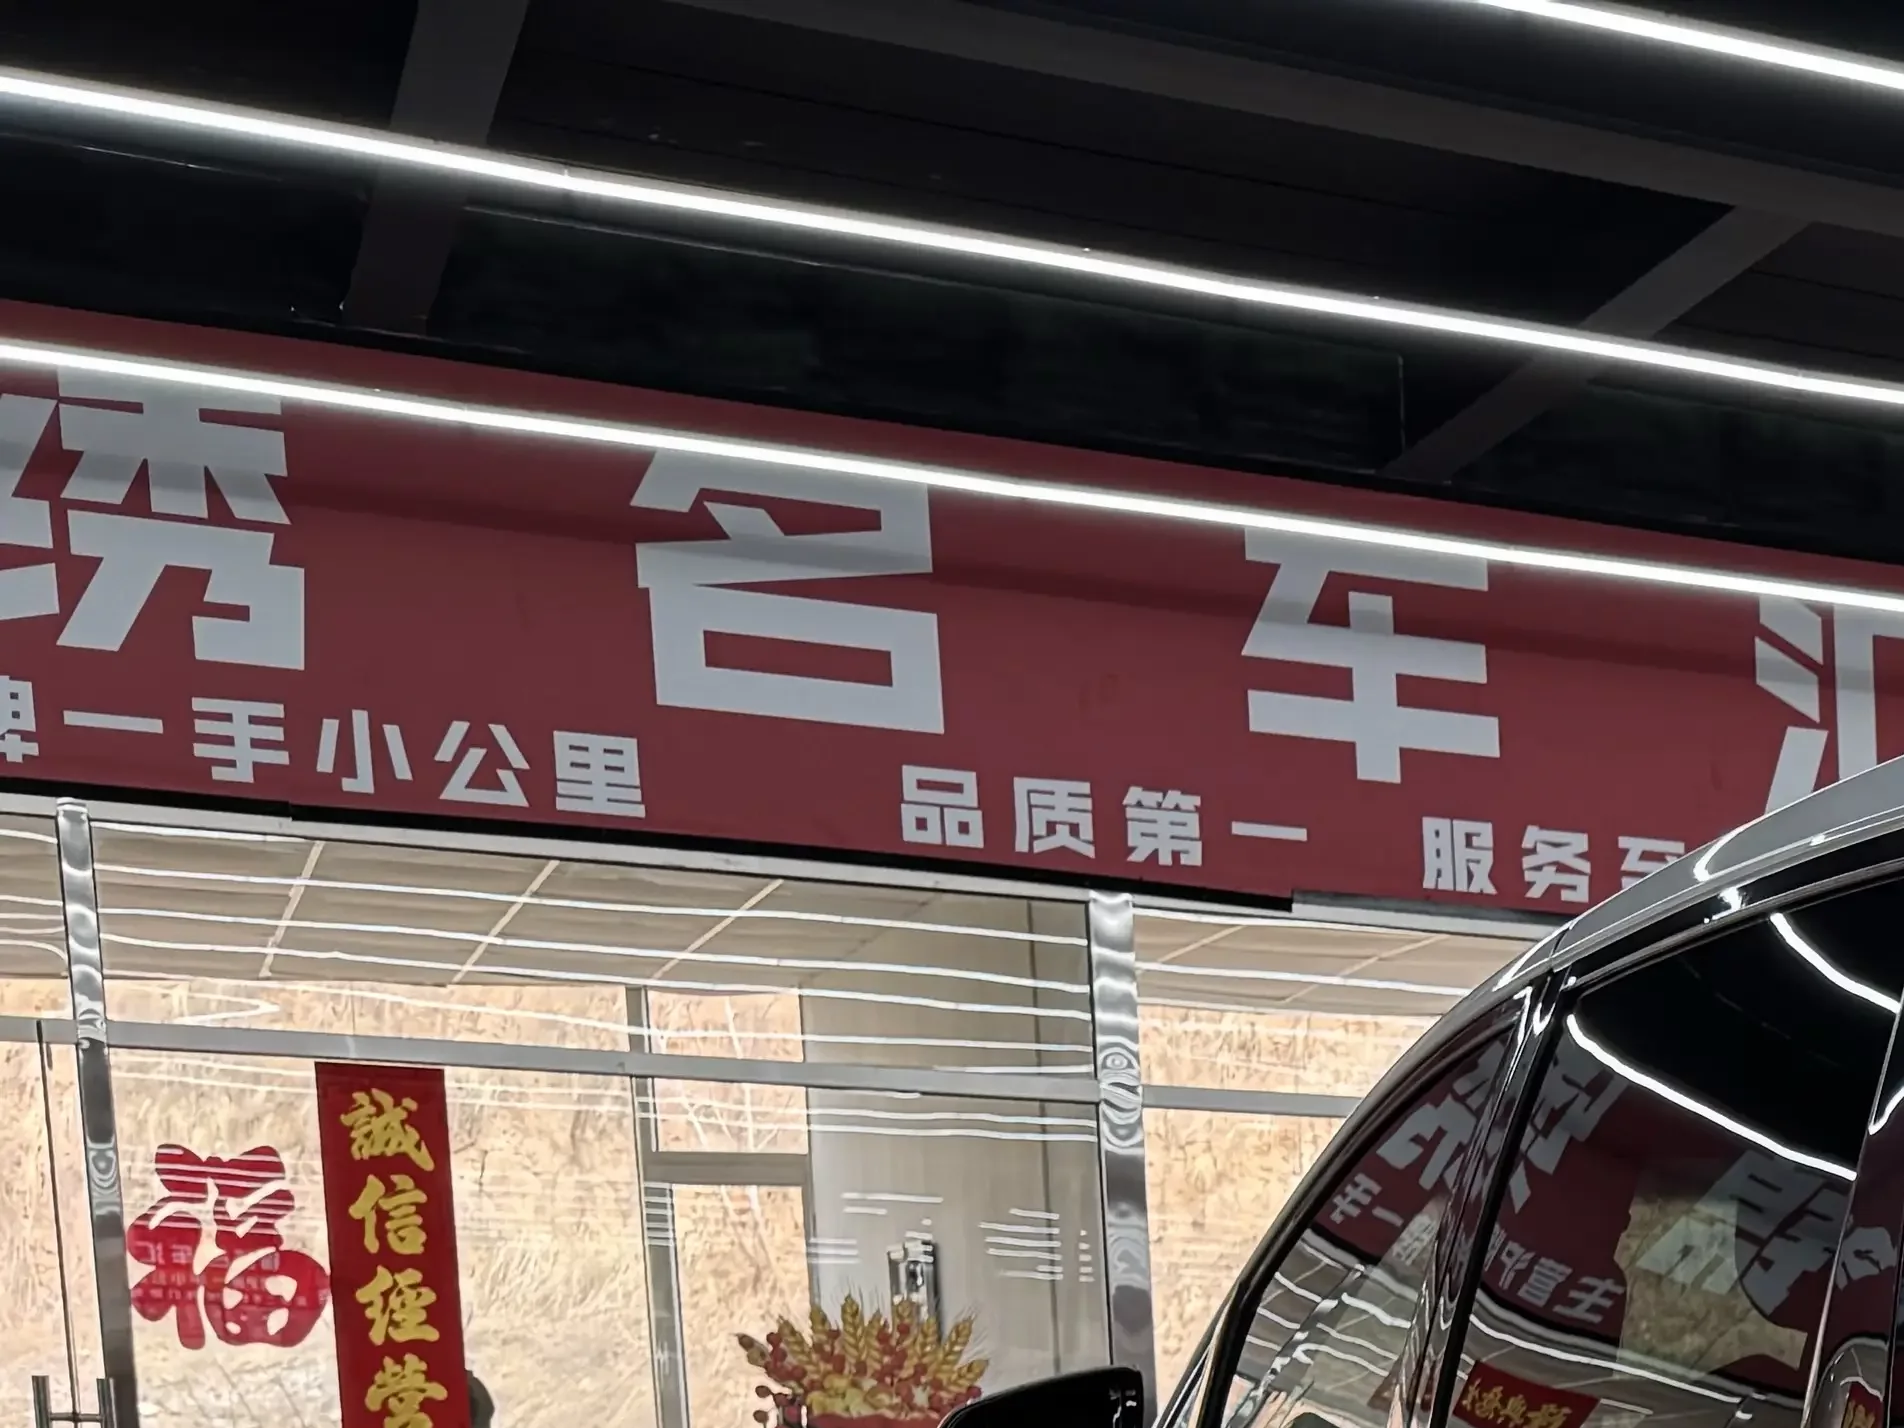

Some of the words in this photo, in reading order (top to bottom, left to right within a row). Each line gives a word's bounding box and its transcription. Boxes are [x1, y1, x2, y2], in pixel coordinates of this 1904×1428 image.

[900, 765, 1309, 867] 品质第一
[126, 1144, 332, 1350] 福
